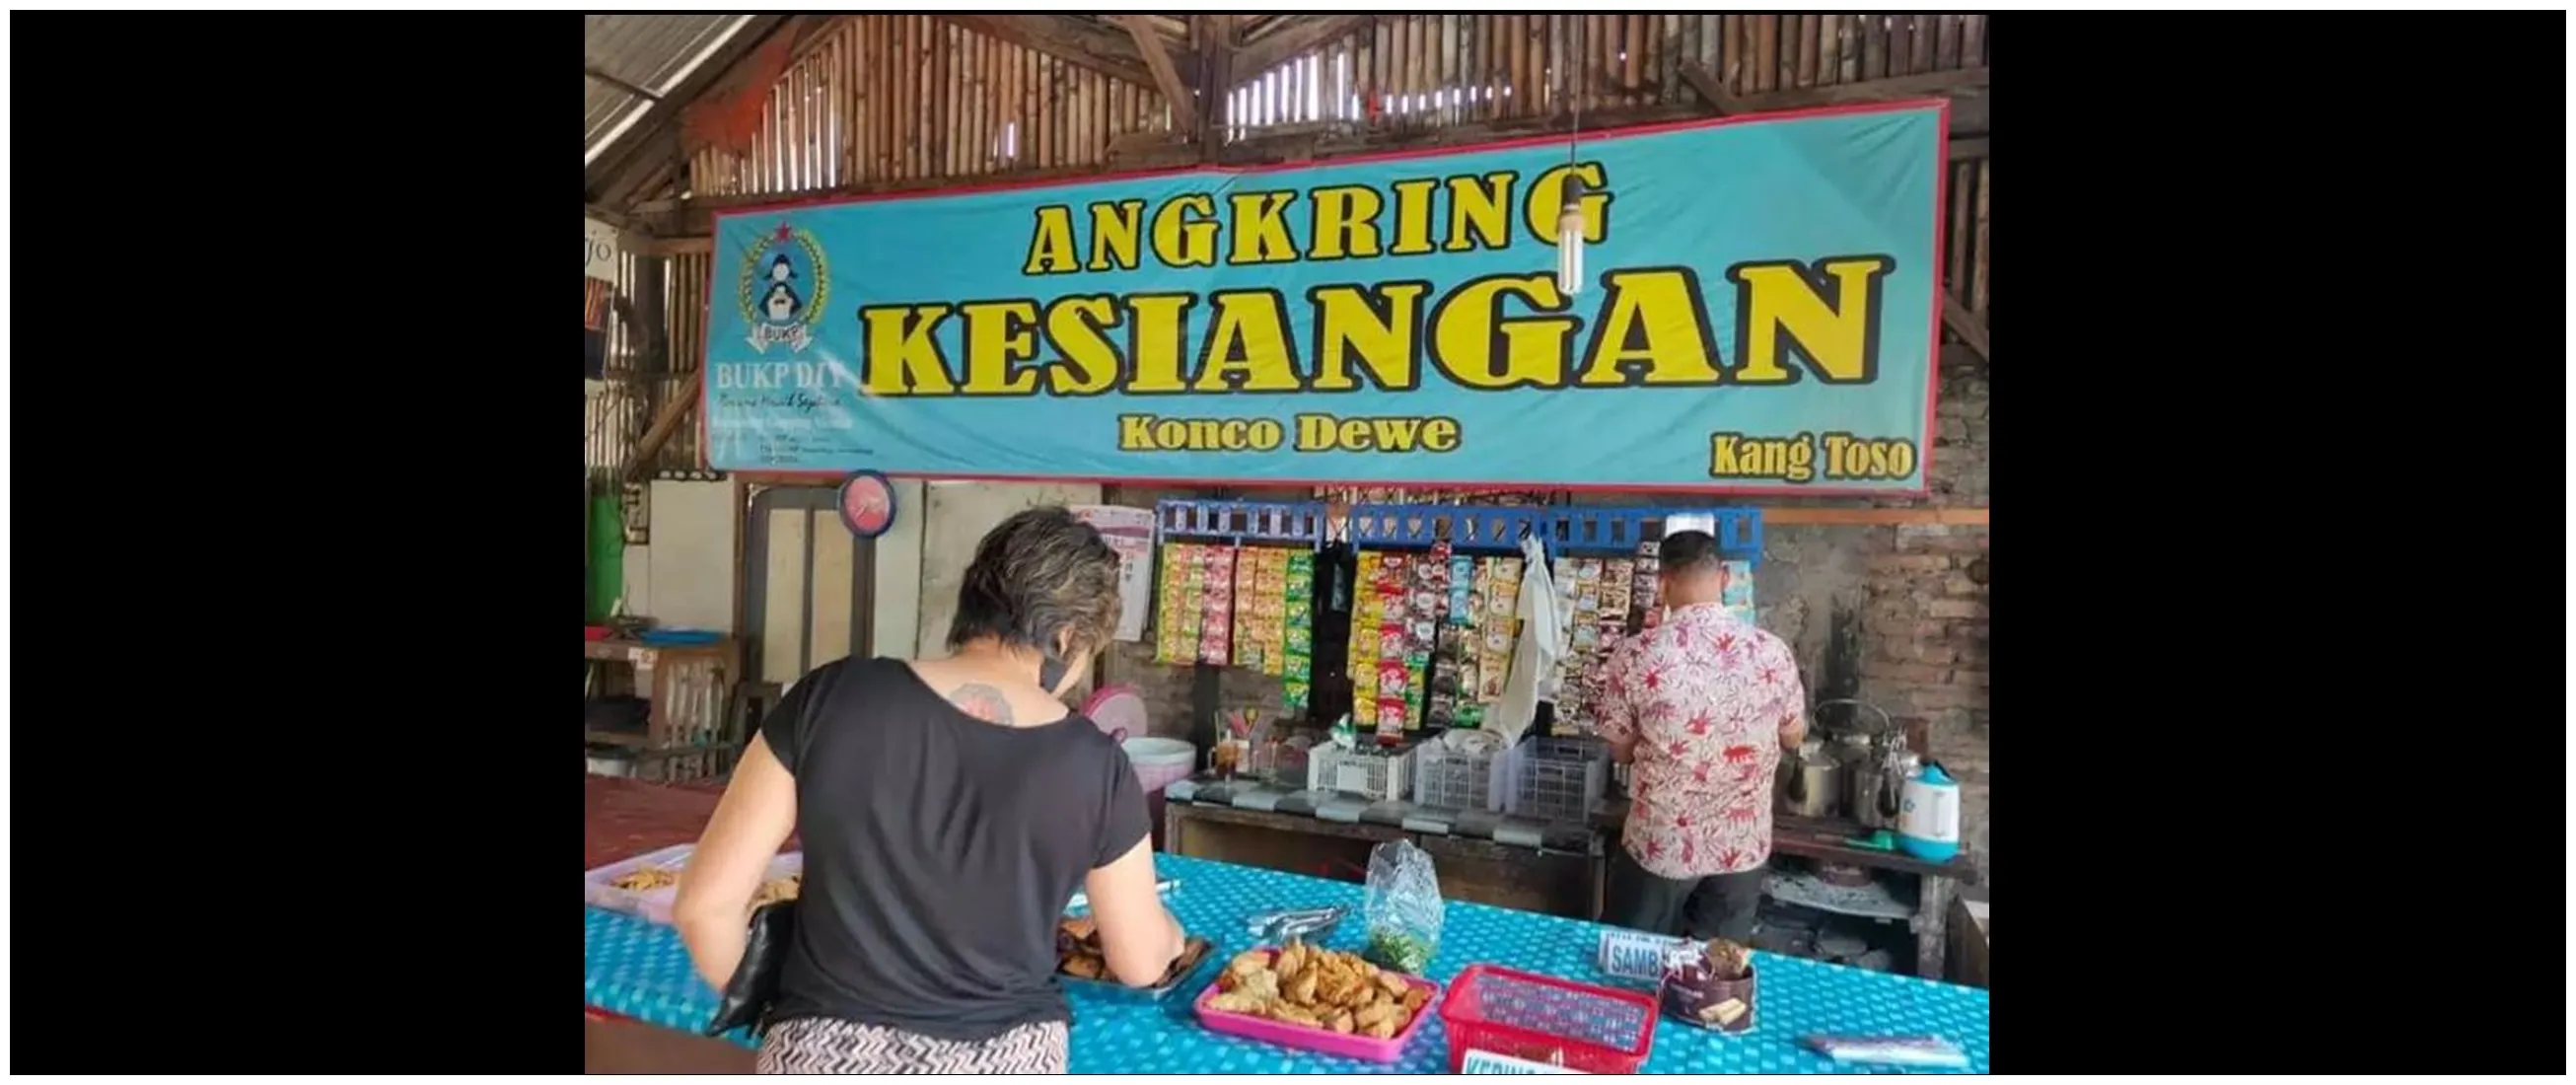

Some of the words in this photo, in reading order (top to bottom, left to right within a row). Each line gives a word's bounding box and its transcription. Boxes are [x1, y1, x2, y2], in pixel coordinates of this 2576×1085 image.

[1022, 160, 1614, 276] ANGKRING
[860, 254, 1895, 396] KESIANGAN
[716, 361, 789, 389] BUKP
[796, 361, 845, 389] DIY
[1117, 411, 1287, 454] Konco
[1292, 413, 1463, 455] Dewe
[1710, 432, 1818, 483] Kang
[1824, 432, 1918, 480] Toso
[1611, 944, 1660, 978] SAMB
